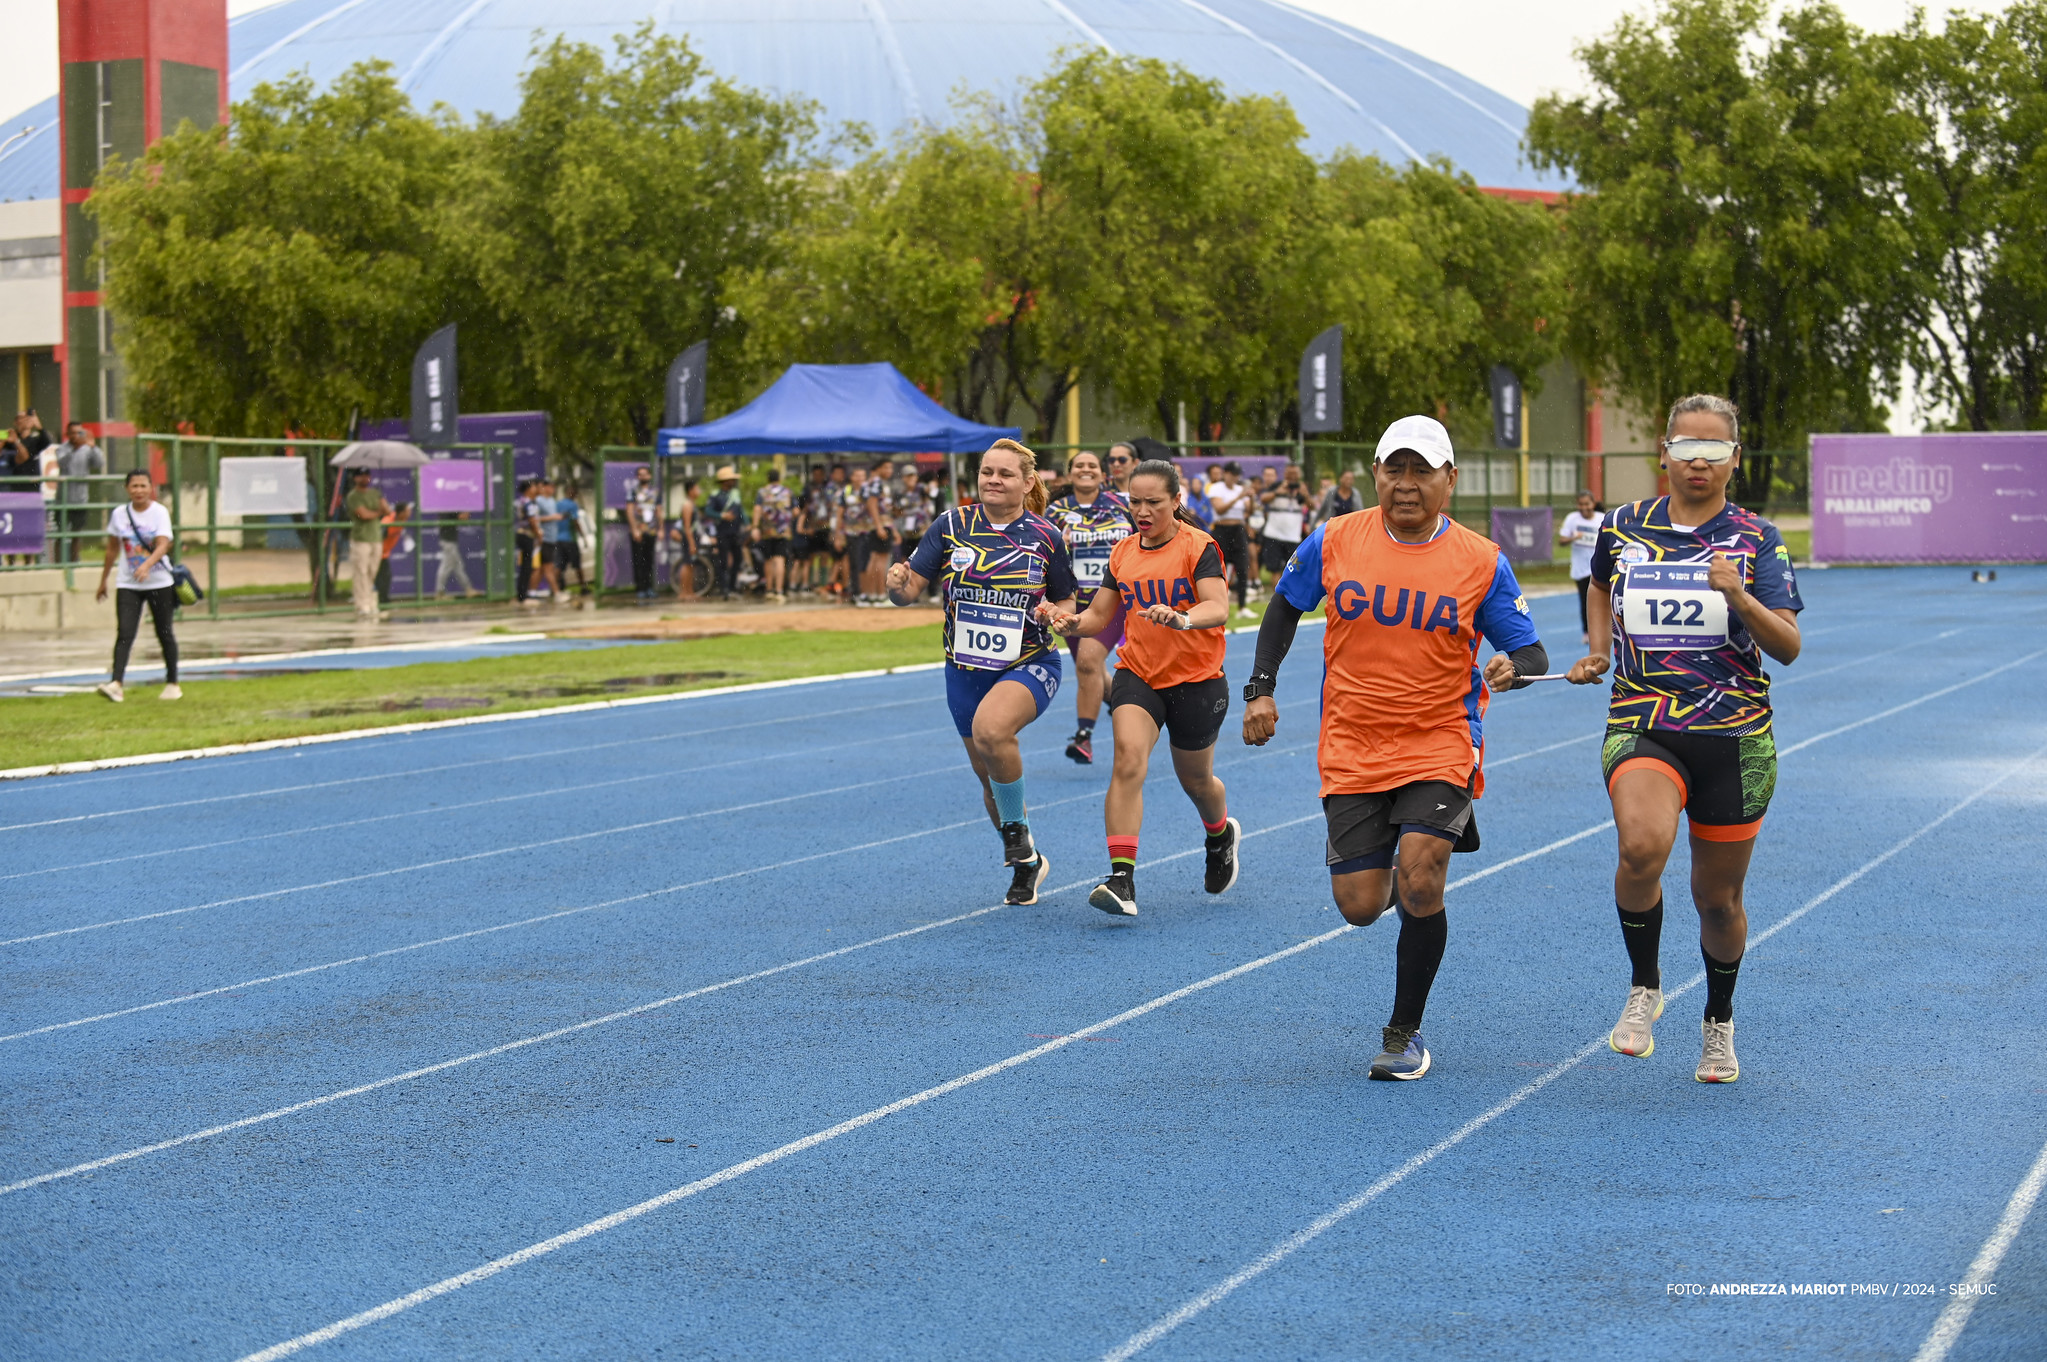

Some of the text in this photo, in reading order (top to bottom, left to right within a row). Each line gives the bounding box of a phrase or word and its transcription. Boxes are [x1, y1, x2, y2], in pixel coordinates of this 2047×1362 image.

[1824, 457, 1953, 504] meeting
[952, 586, 1031, 609] RORAIMA
[1117, 578, 1196, 611] GUIA
[1334, 580, 1459, 635] GUIA
[1645, 598, 1705, 627] 122
[966, 629, 1007, 653] 109
